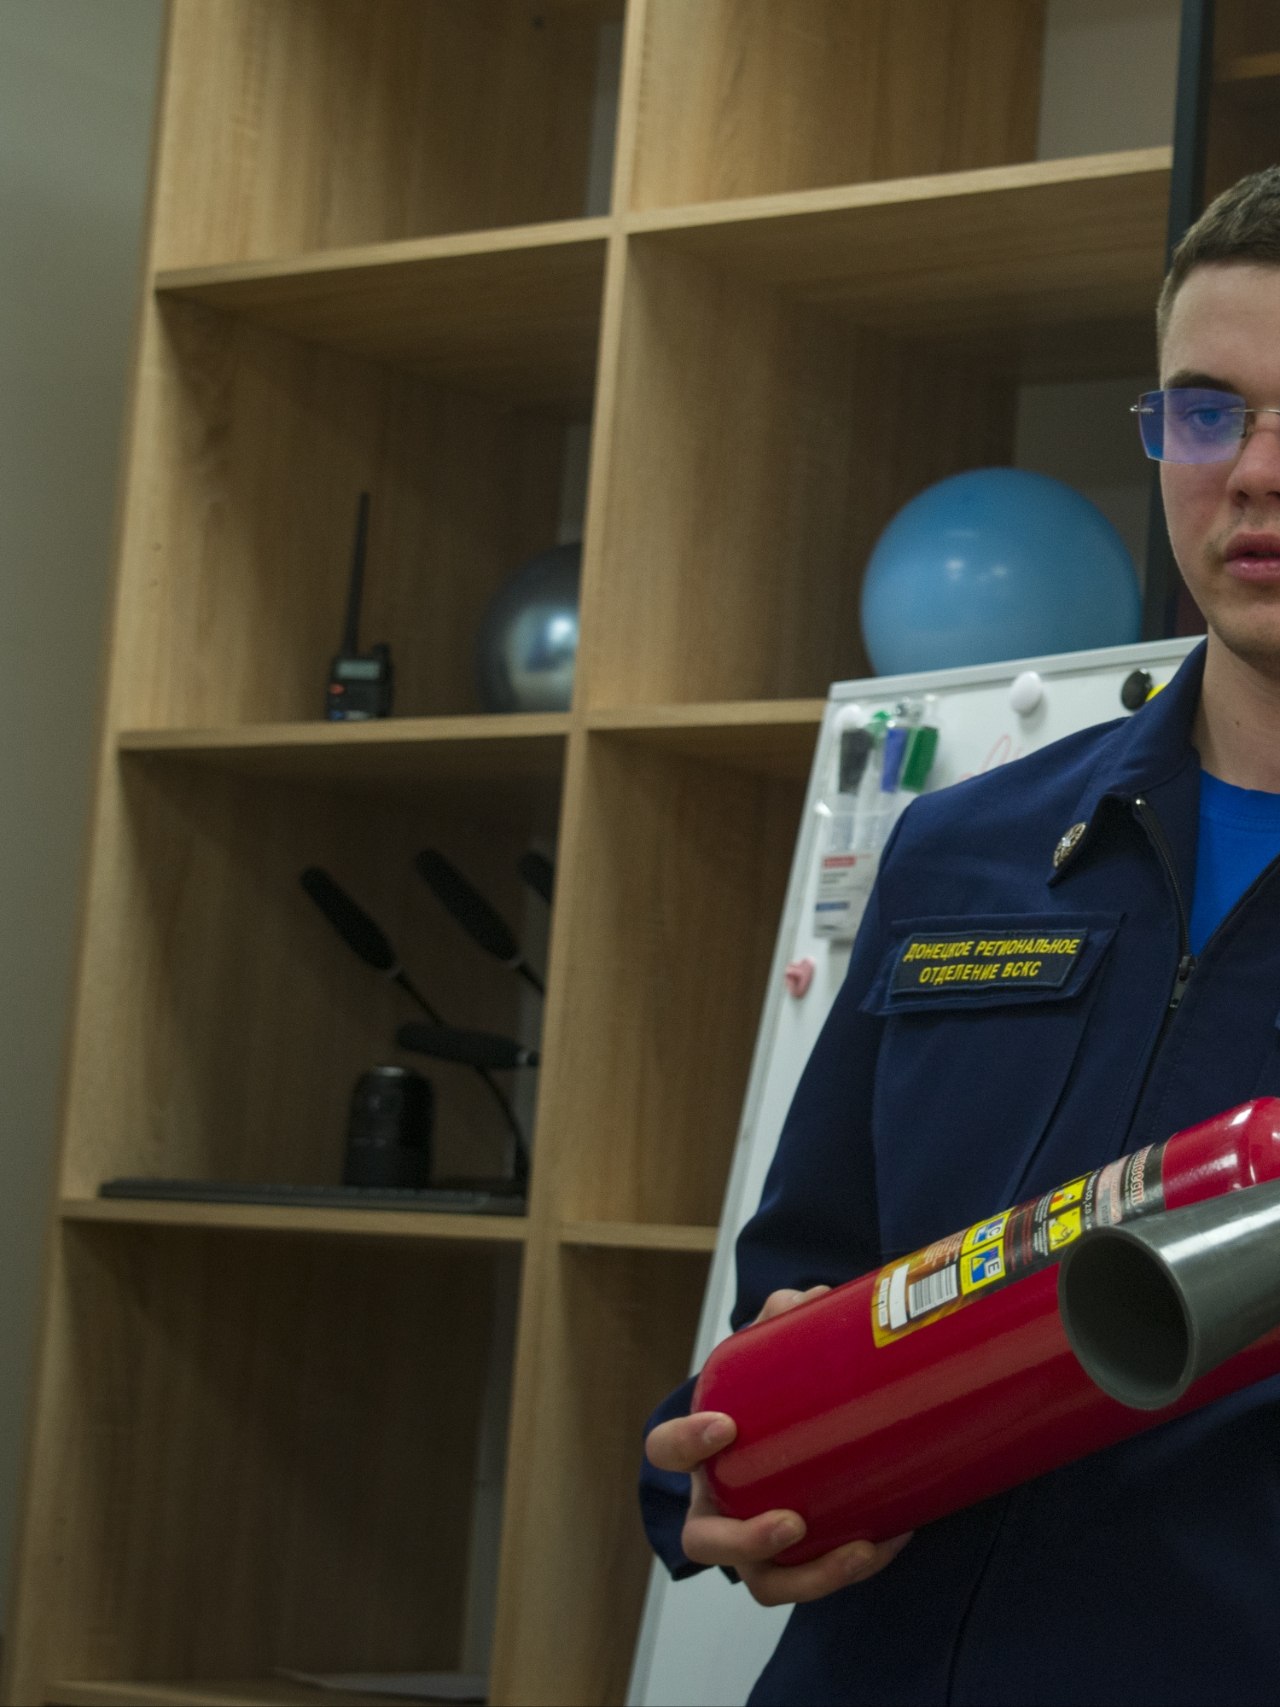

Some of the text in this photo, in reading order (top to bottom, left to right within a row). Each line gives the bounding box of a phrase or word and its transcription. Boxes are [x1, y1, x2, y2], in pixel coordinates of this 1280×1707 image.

[903, 938, 1080, 962] ДОНЕЦКОЕ РЕГИОНАЛЬНОЕ
[919, 961, 1042, 985] ОТДЕЛЕНИЕ ВСКС
